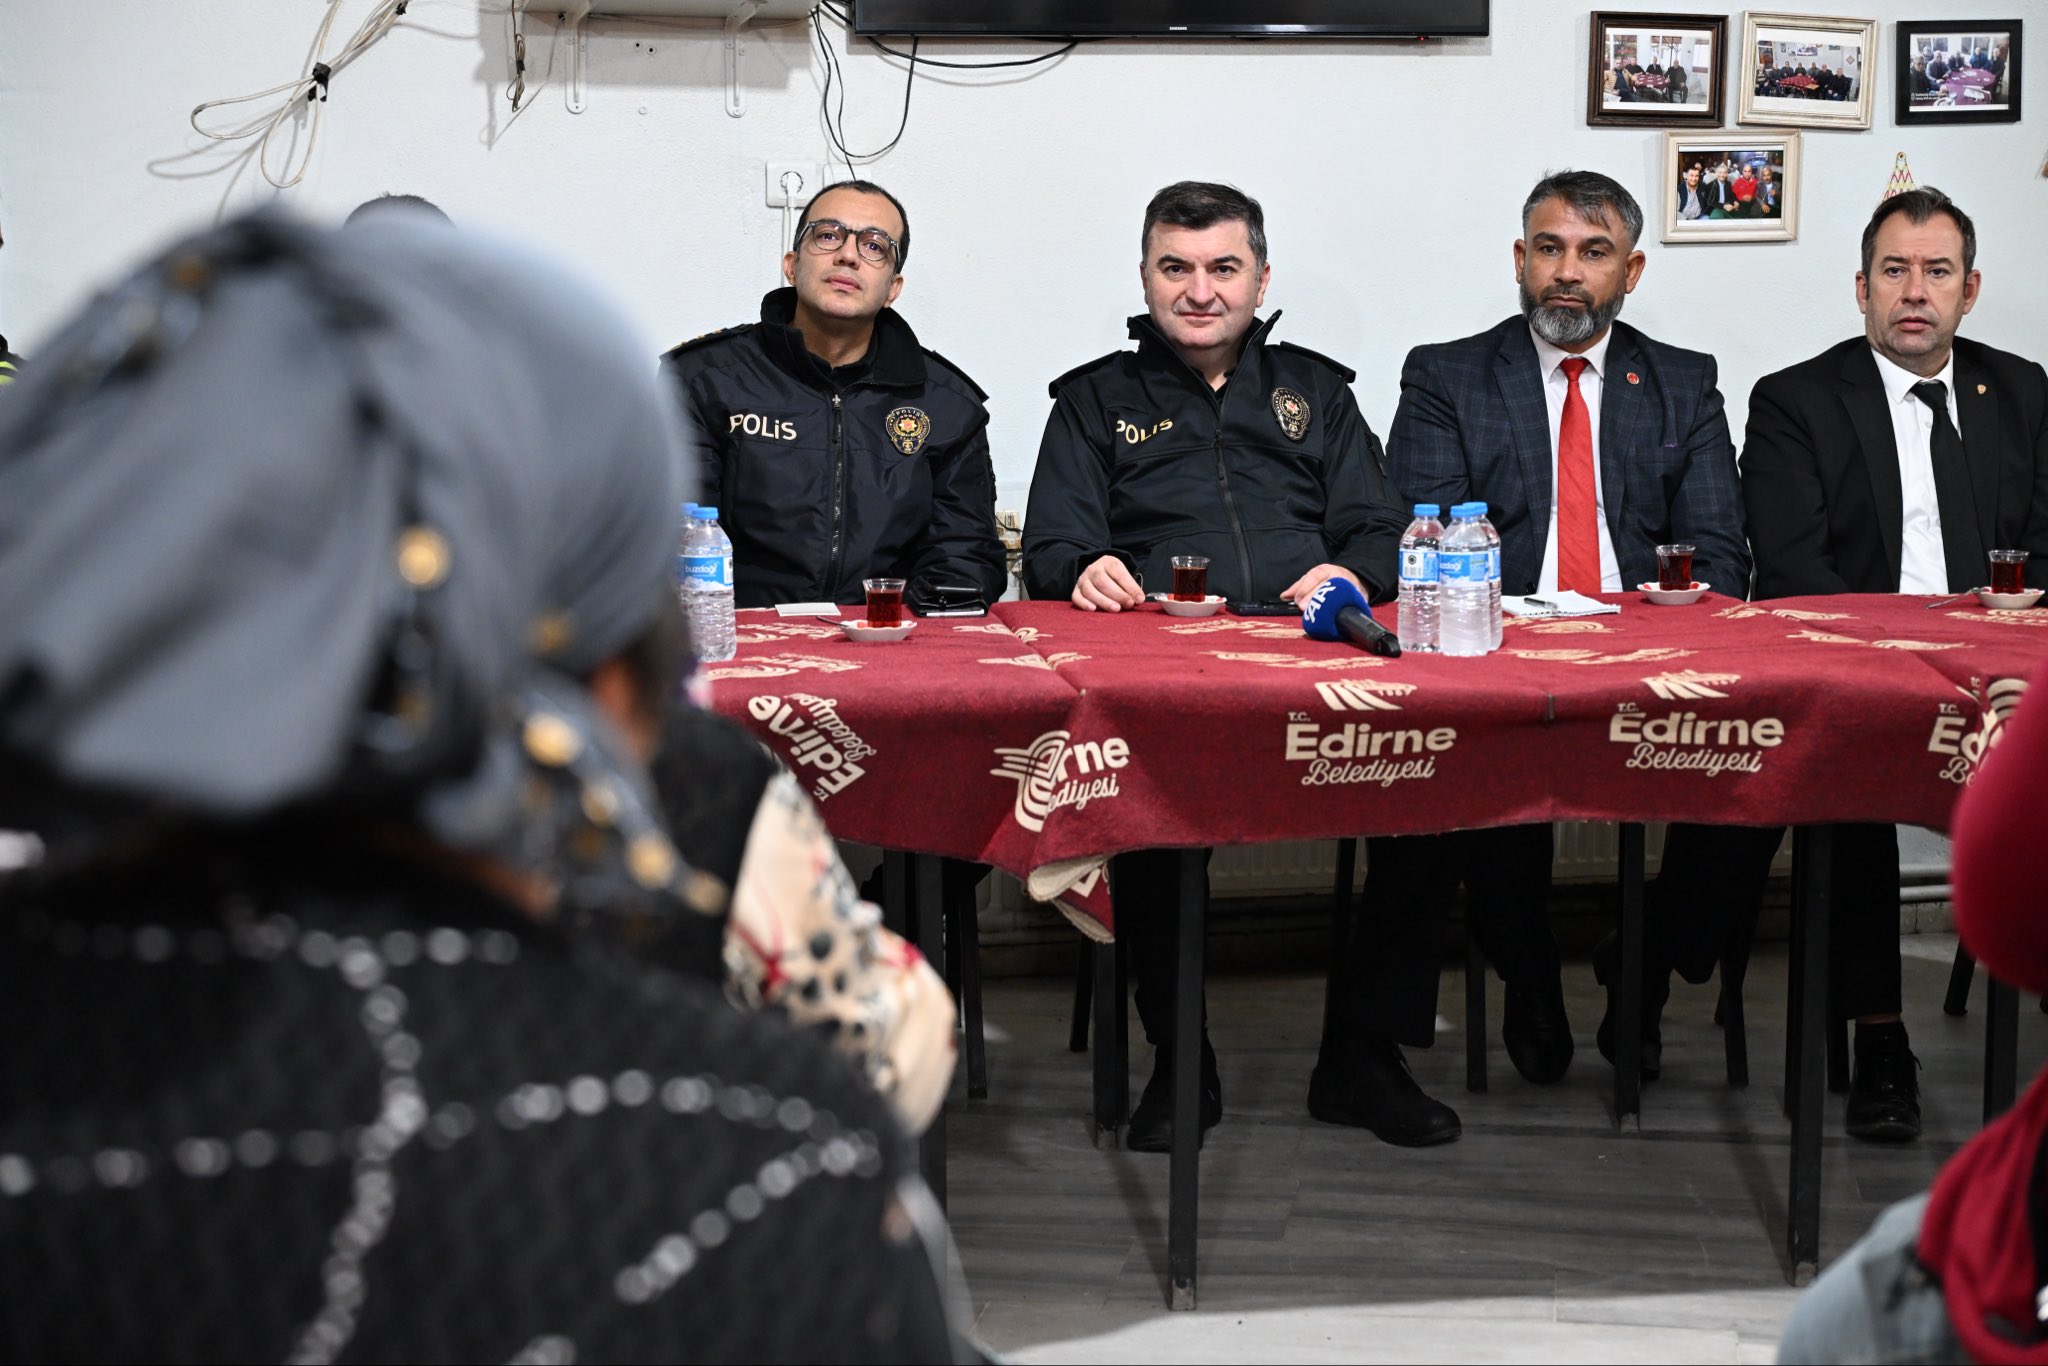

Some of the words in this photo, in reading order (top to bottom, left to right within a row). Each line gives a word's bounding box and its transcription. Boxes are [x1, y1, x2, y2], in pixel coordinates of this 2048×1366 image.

[748, 695, 866, 795] Edirne
[1285, 723, 1457, 760] Edirne
[1609, 712, 1785, 747] Edirne
[1301, 755, 1436, 788] Belediyesi
[1626, 742, 1763, 777] Belediyesi
